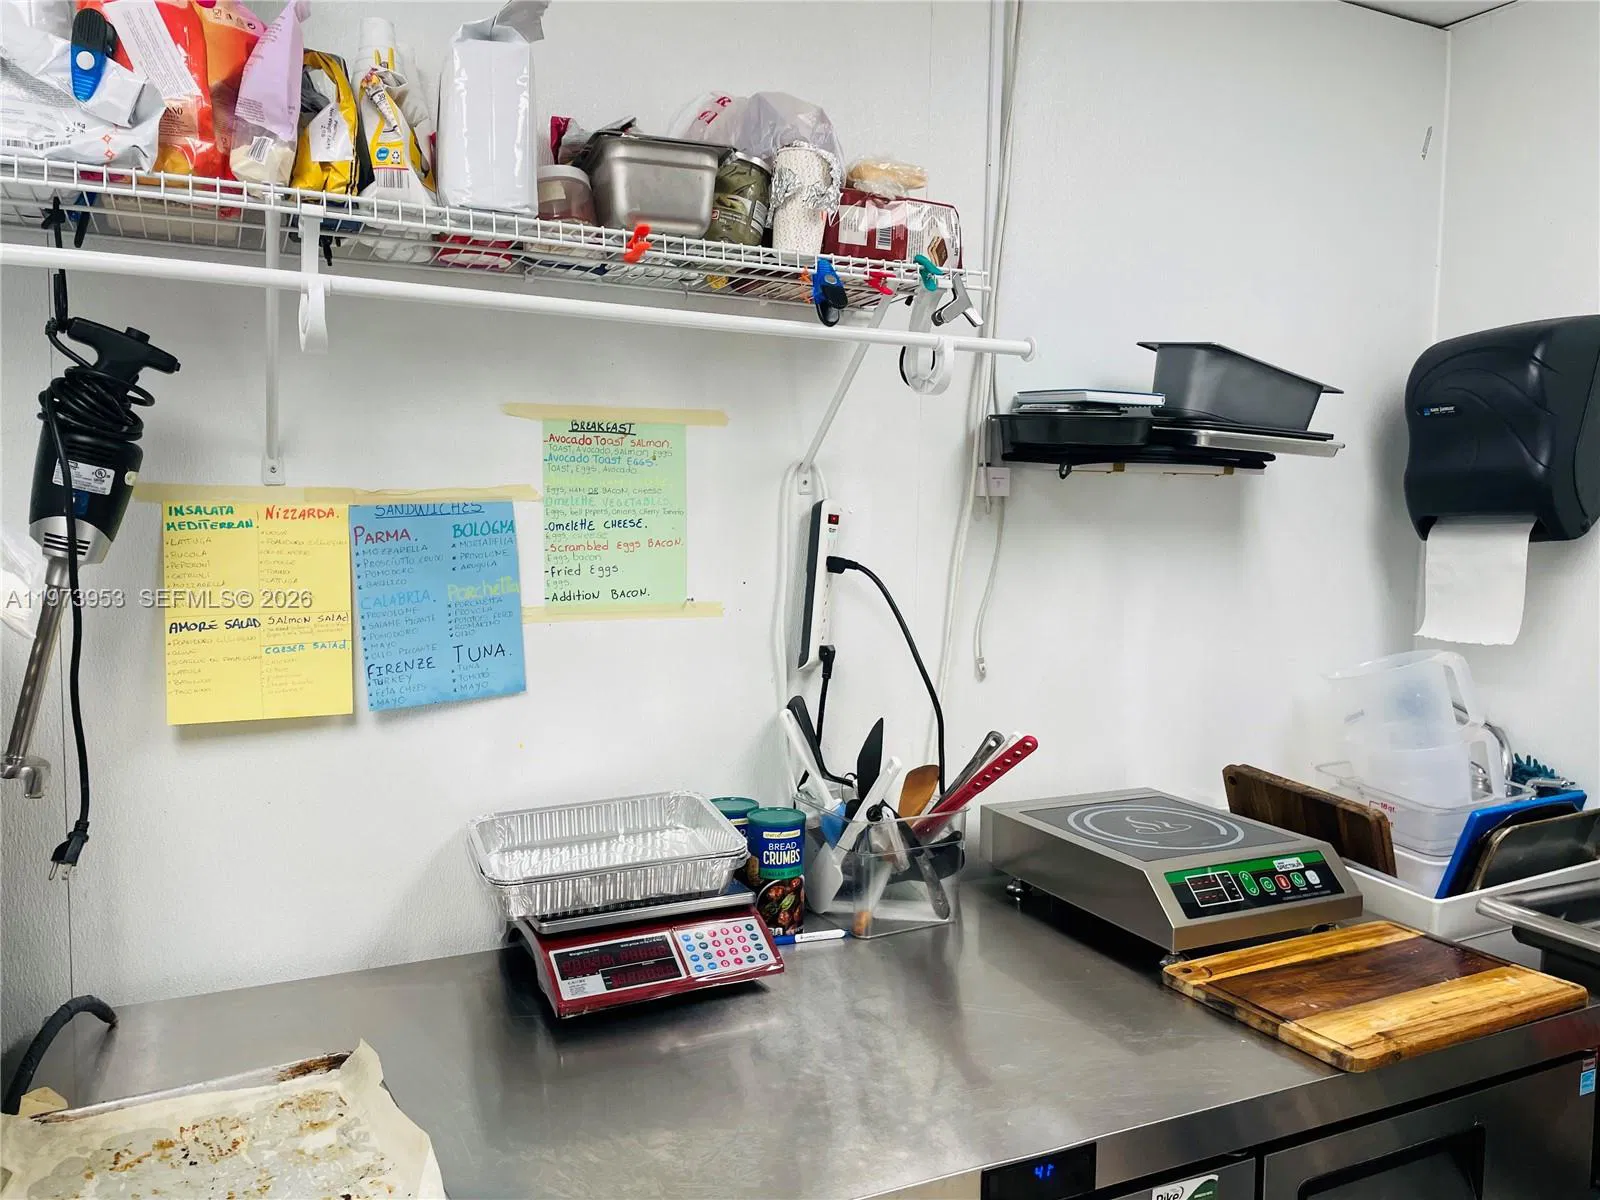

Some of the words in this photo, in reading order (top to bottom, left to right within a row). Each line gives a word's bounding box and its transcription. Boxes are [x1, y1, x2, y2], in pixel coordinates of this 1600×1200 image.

[570, 420, 635, 433] BREAKFAST
[168, 505, 234, 516] INSALATA
[374, 502, 482, 517] SANDWICHES
[224, 617, 261, 630] SALAD
[367, 656, 436, 680] FIRENZE
[768, 841, 797, 851] BREAD
[763, 849, 800, 865] CRUMBS
